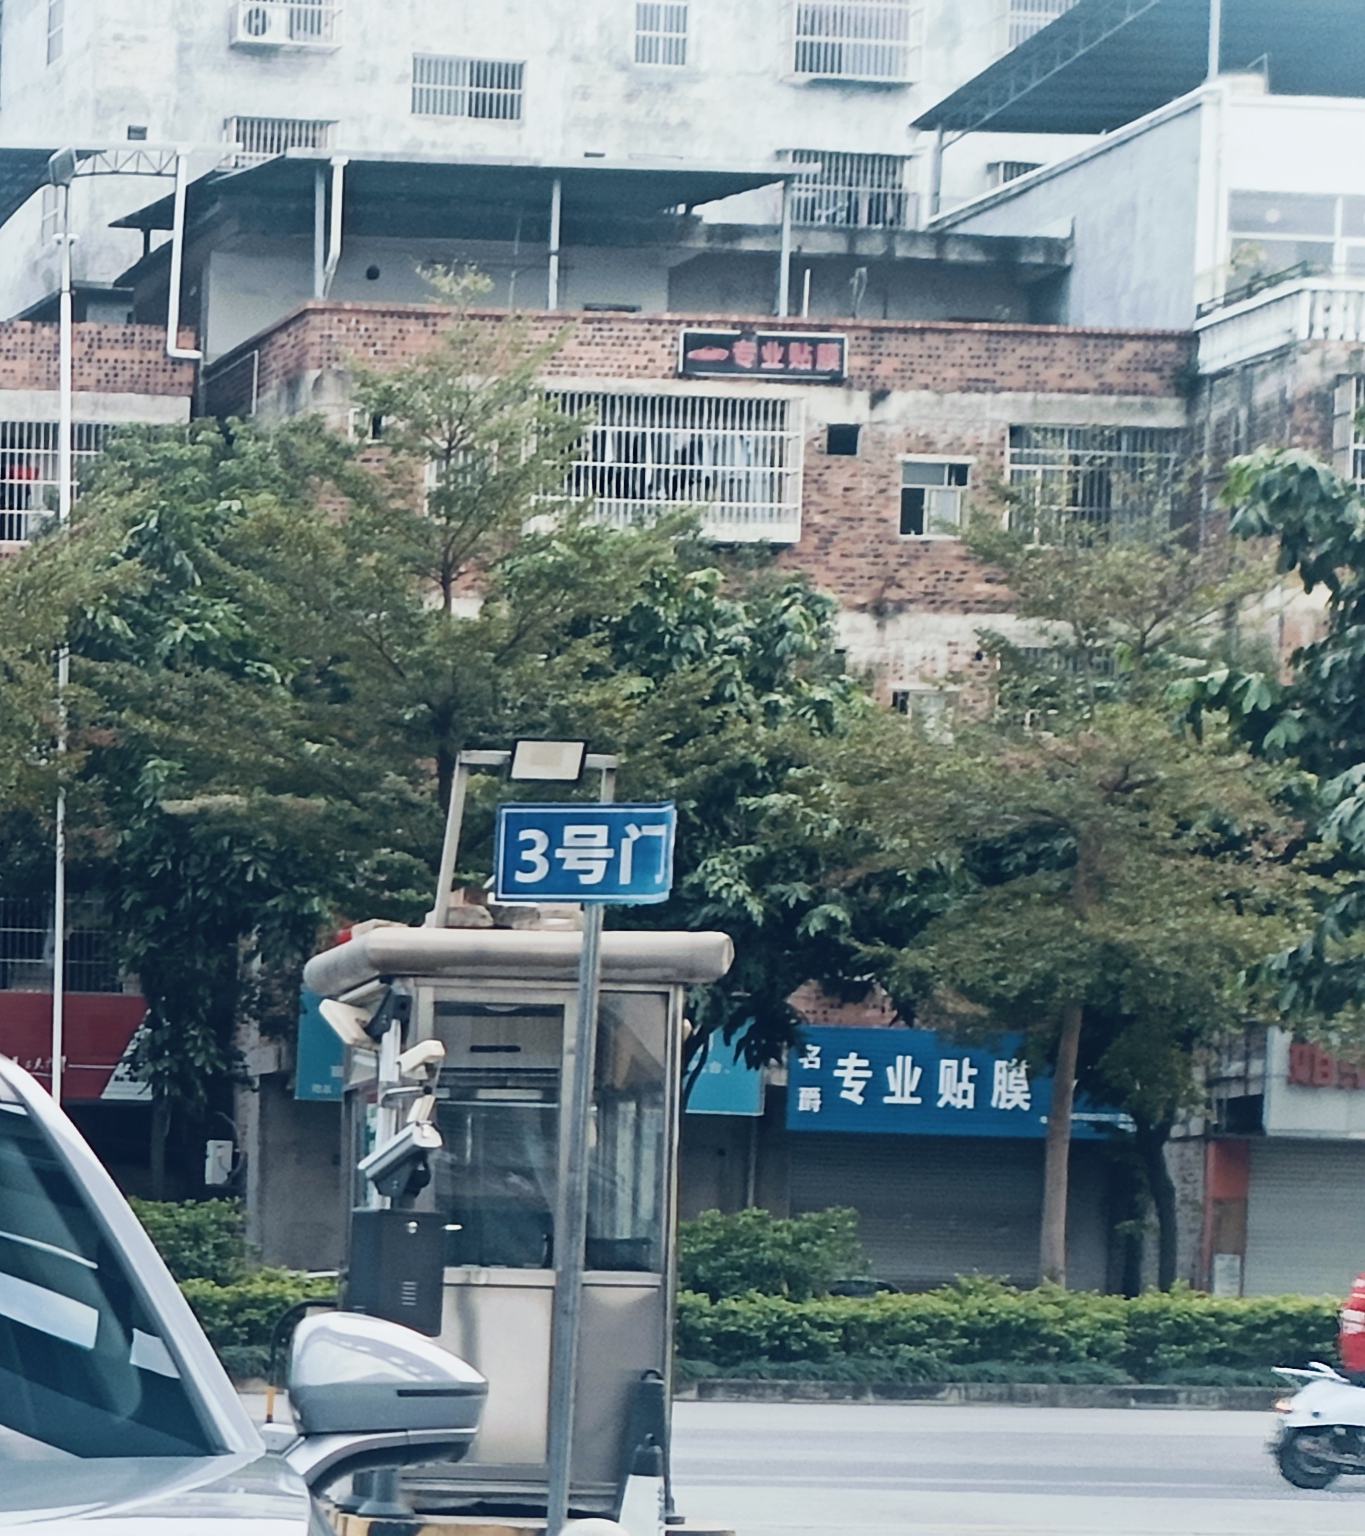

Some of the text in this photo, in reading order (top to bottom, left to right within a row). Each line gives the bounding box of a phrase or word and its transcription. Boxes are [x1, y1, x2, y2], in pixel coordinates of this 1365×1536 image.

[514, 823, 668, 885] 3号门
[832, 1051, 1031, 1111] 专业贴膜
